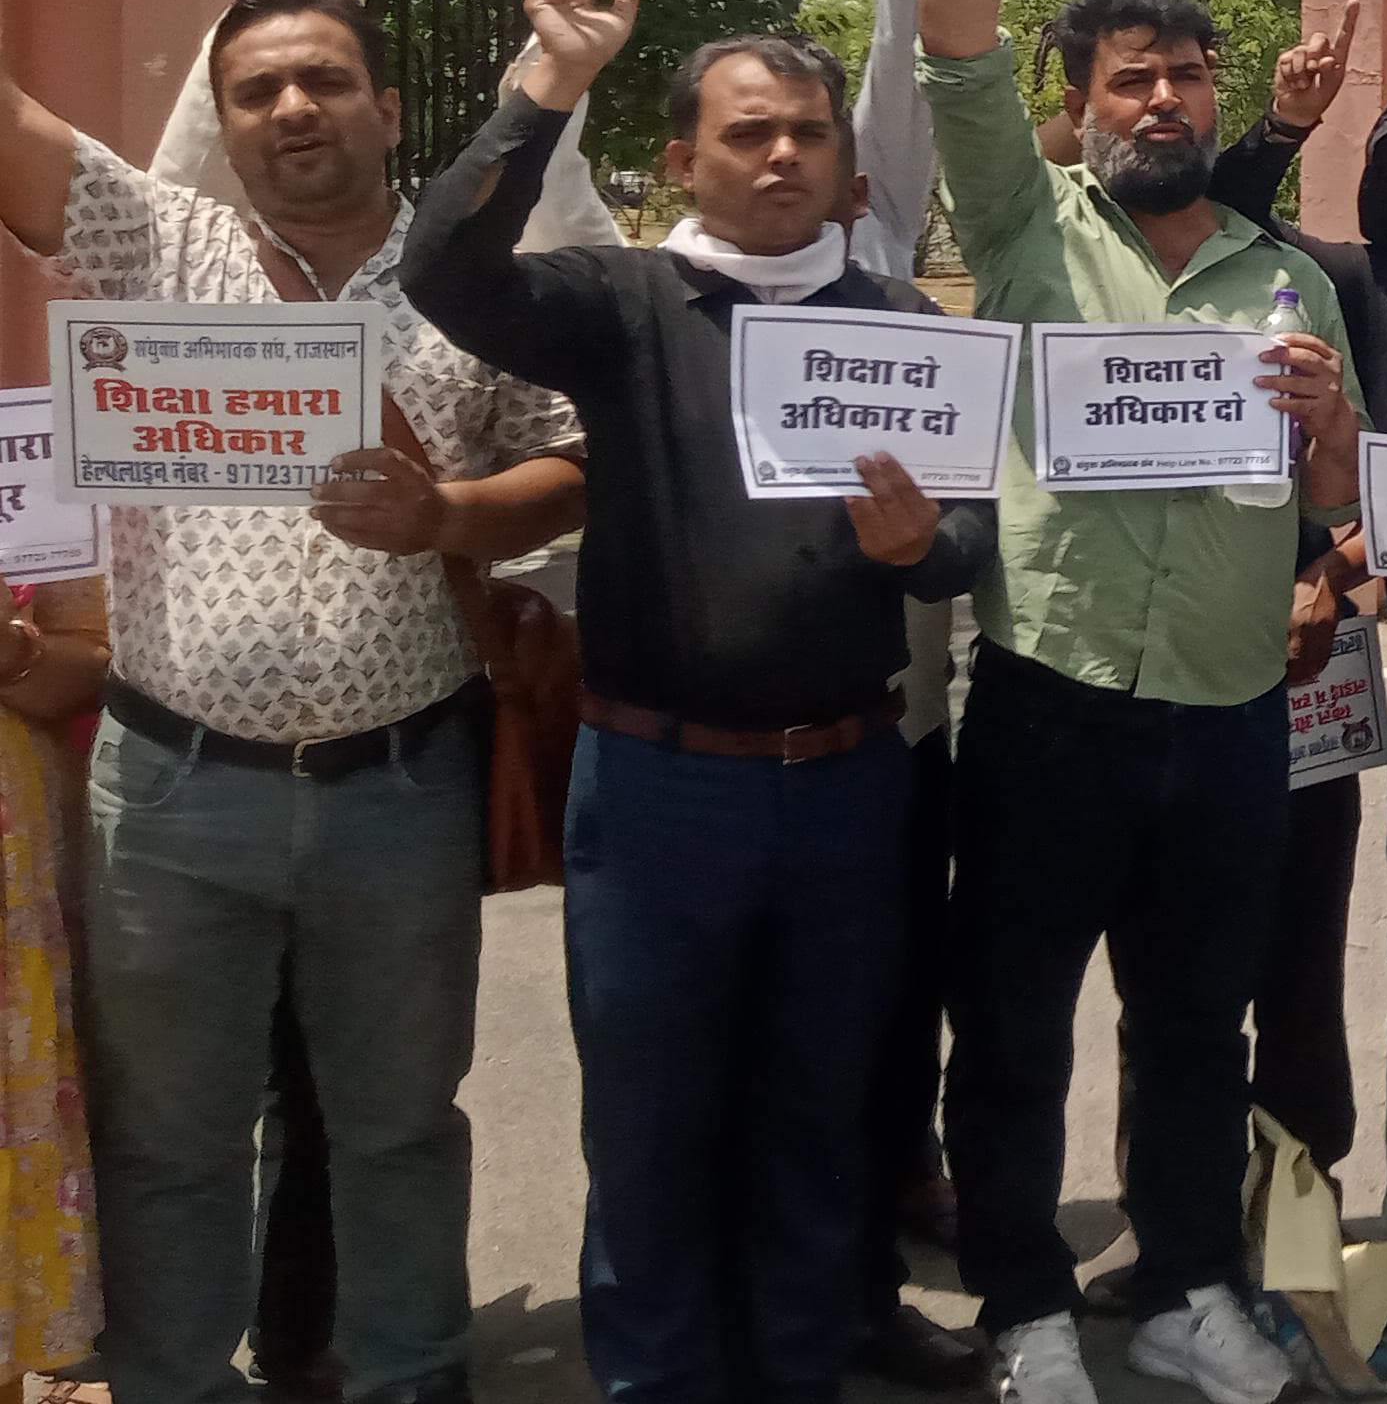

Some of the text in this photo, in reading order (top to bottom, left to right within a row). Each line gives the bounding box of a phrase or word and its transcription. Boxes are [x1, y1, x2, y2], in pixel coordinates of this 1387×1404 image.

[803, 349, 941, 388] शिक्षा दो
[1103, 352, 1225, 384] शिक्षा दो
[92, 377, 342, 415] शिक्षा हमारा
[1085, 391, 1246, 425] अधिकार दो
[780, 395, 960, 435] अधिकार दो
[132, 419, 306, 455] अधिकार
